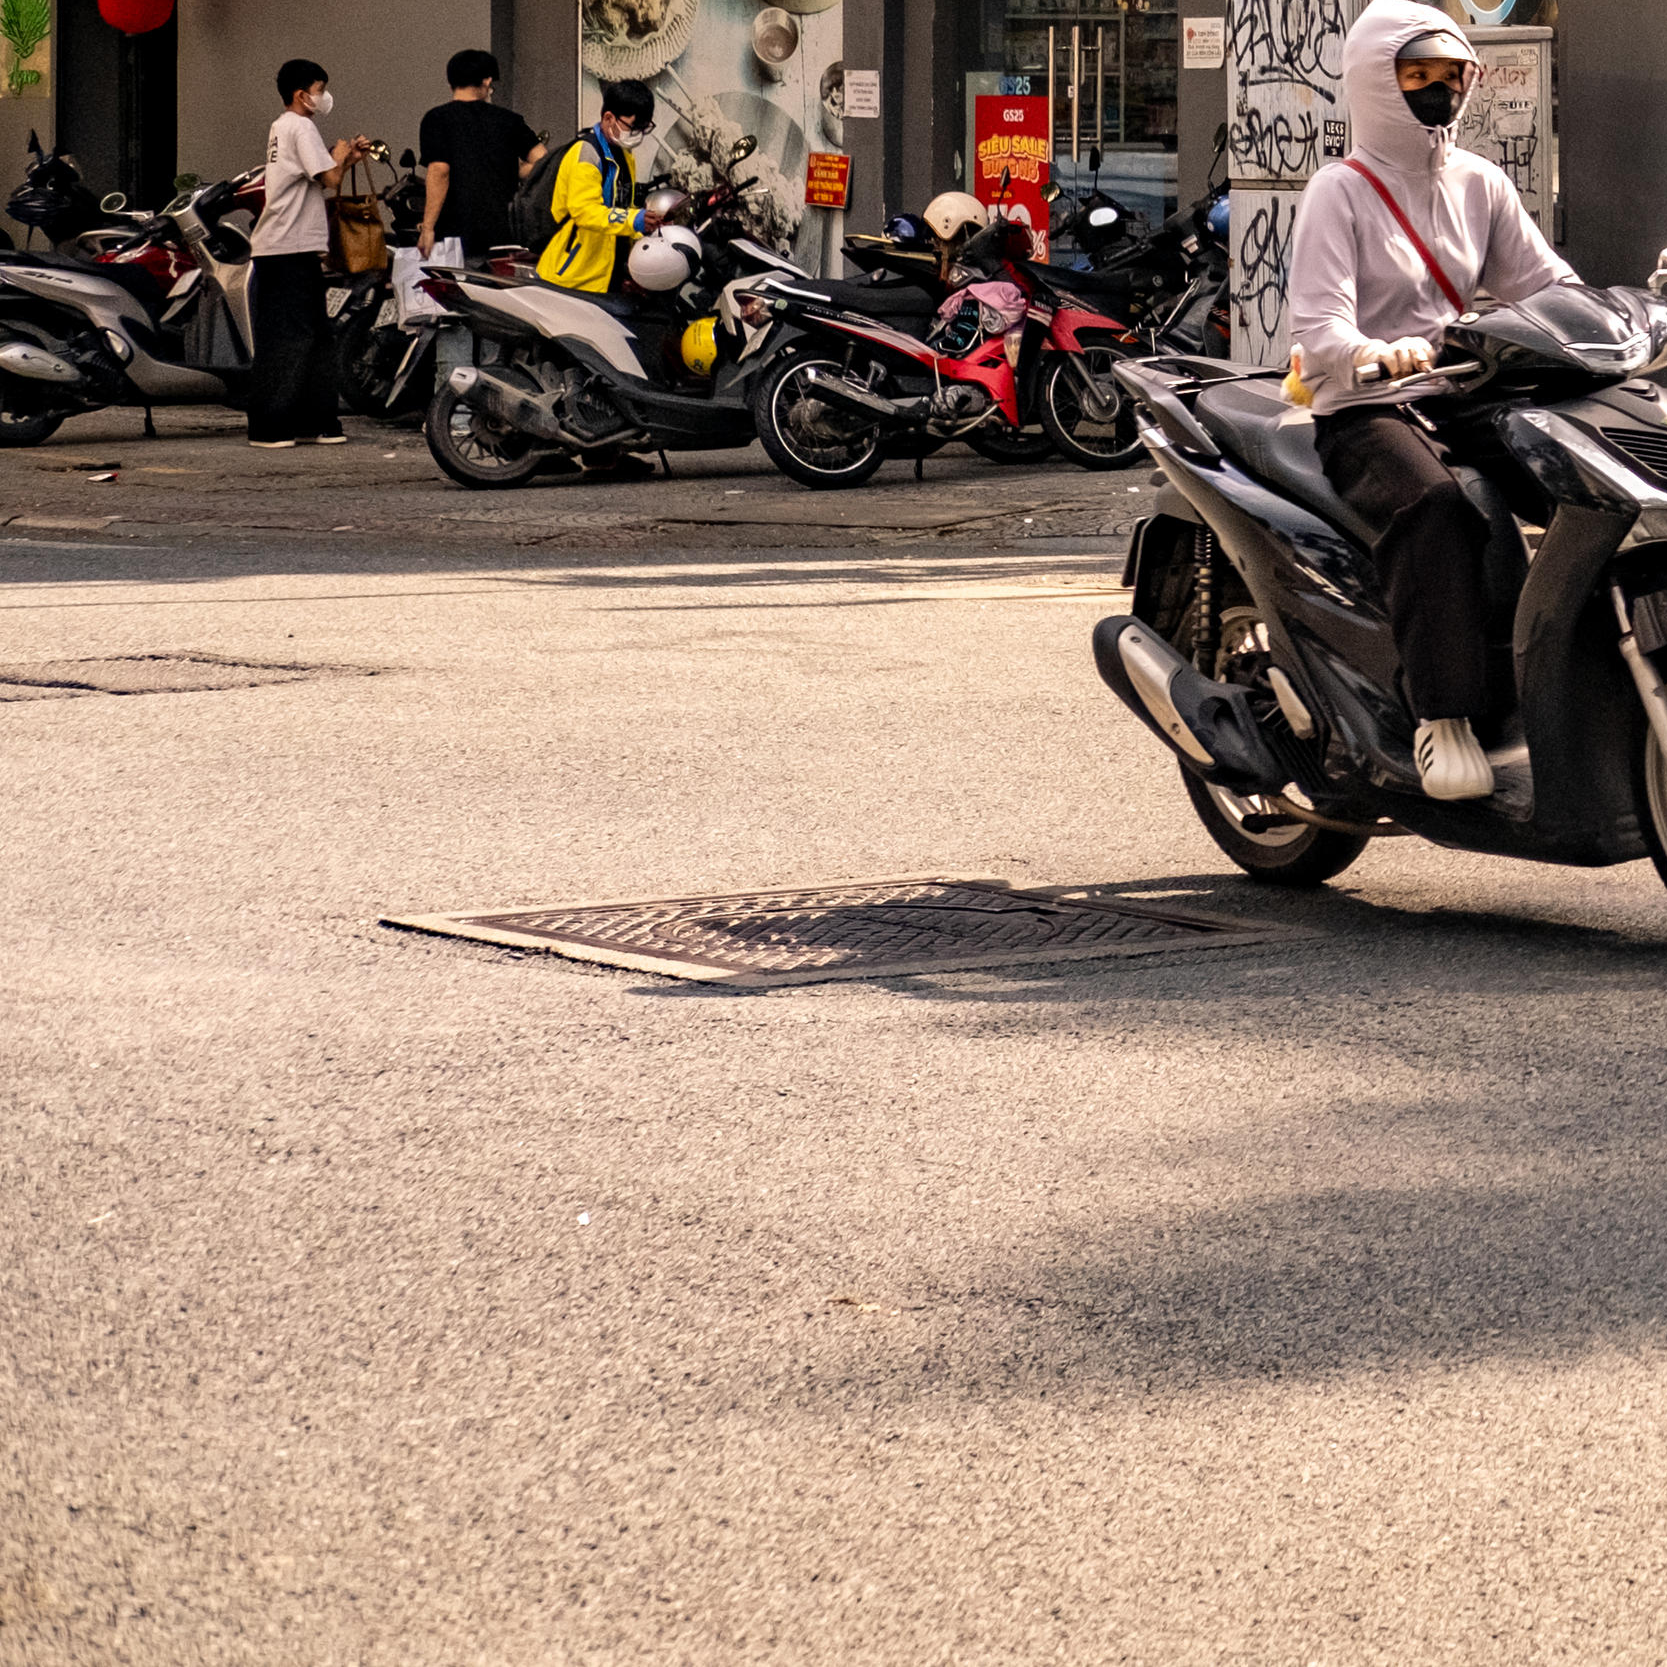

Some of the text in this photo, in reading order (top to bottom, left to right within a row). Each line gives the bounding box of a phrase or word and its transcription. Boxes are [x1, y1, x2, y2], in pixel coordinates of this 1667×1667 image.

[999, 75, 1032, 96] GS25
[1003, 109, 1025, 123] GS25
[977, 133, 1050, 164] SIÊU SALE
[1325, 135, 1345, 147] EVICT
